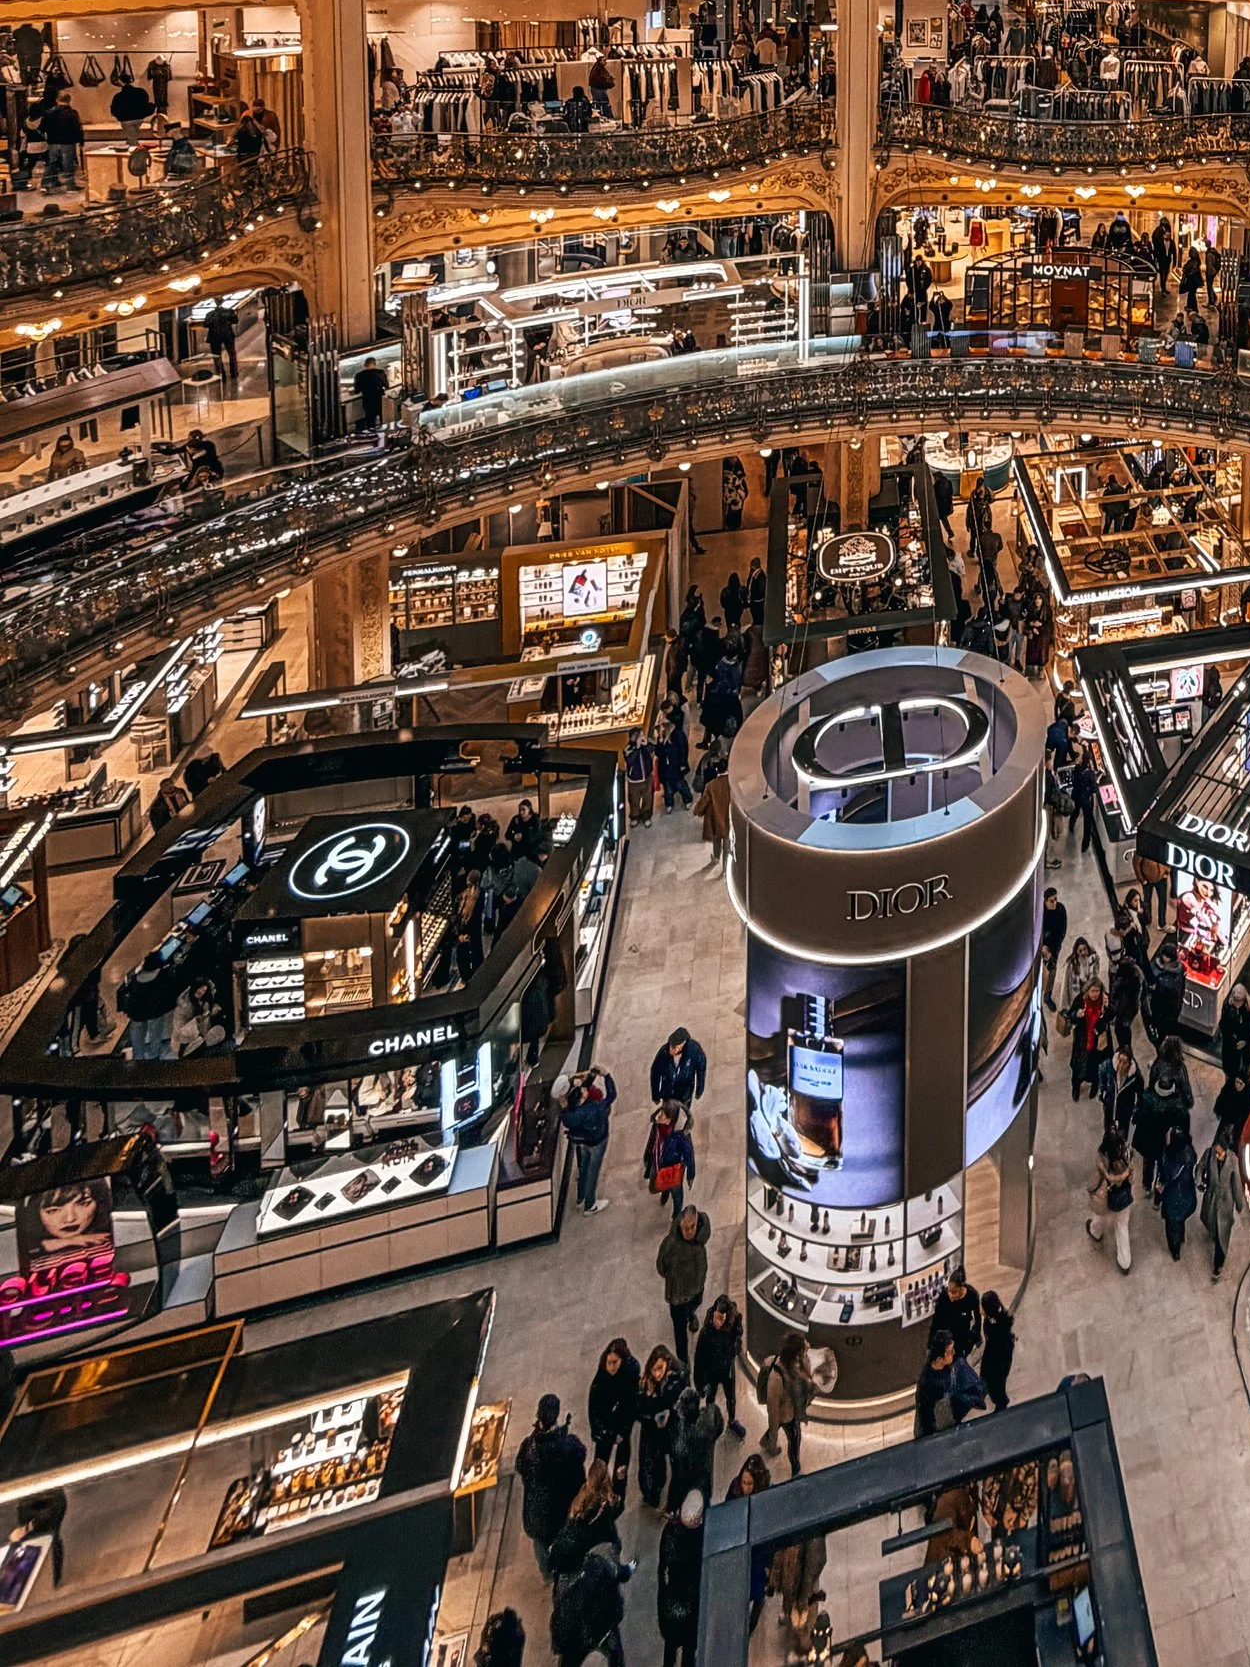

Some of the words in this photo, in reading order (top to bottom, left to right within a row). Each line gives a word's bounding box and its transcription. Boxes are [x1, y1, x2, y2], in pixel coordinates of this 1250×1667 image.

[1032, 265, 1090, 277] MOYNAT
[616, 296, 648, 309] DIOR
[830, 563, 884, 574] DIPTYQUE
[103, 704, 130, 723] TOM
[119, 681, 147, 705] FORD
[1177, 813, 1250, 853] DIOR
[1166, 842, 1237, 890] DIOR
[846, 874, 954, 921] DIOR
[246, 933, 289, 944] CHANEL
[369, 1025, 459, 1055] CHANEL
